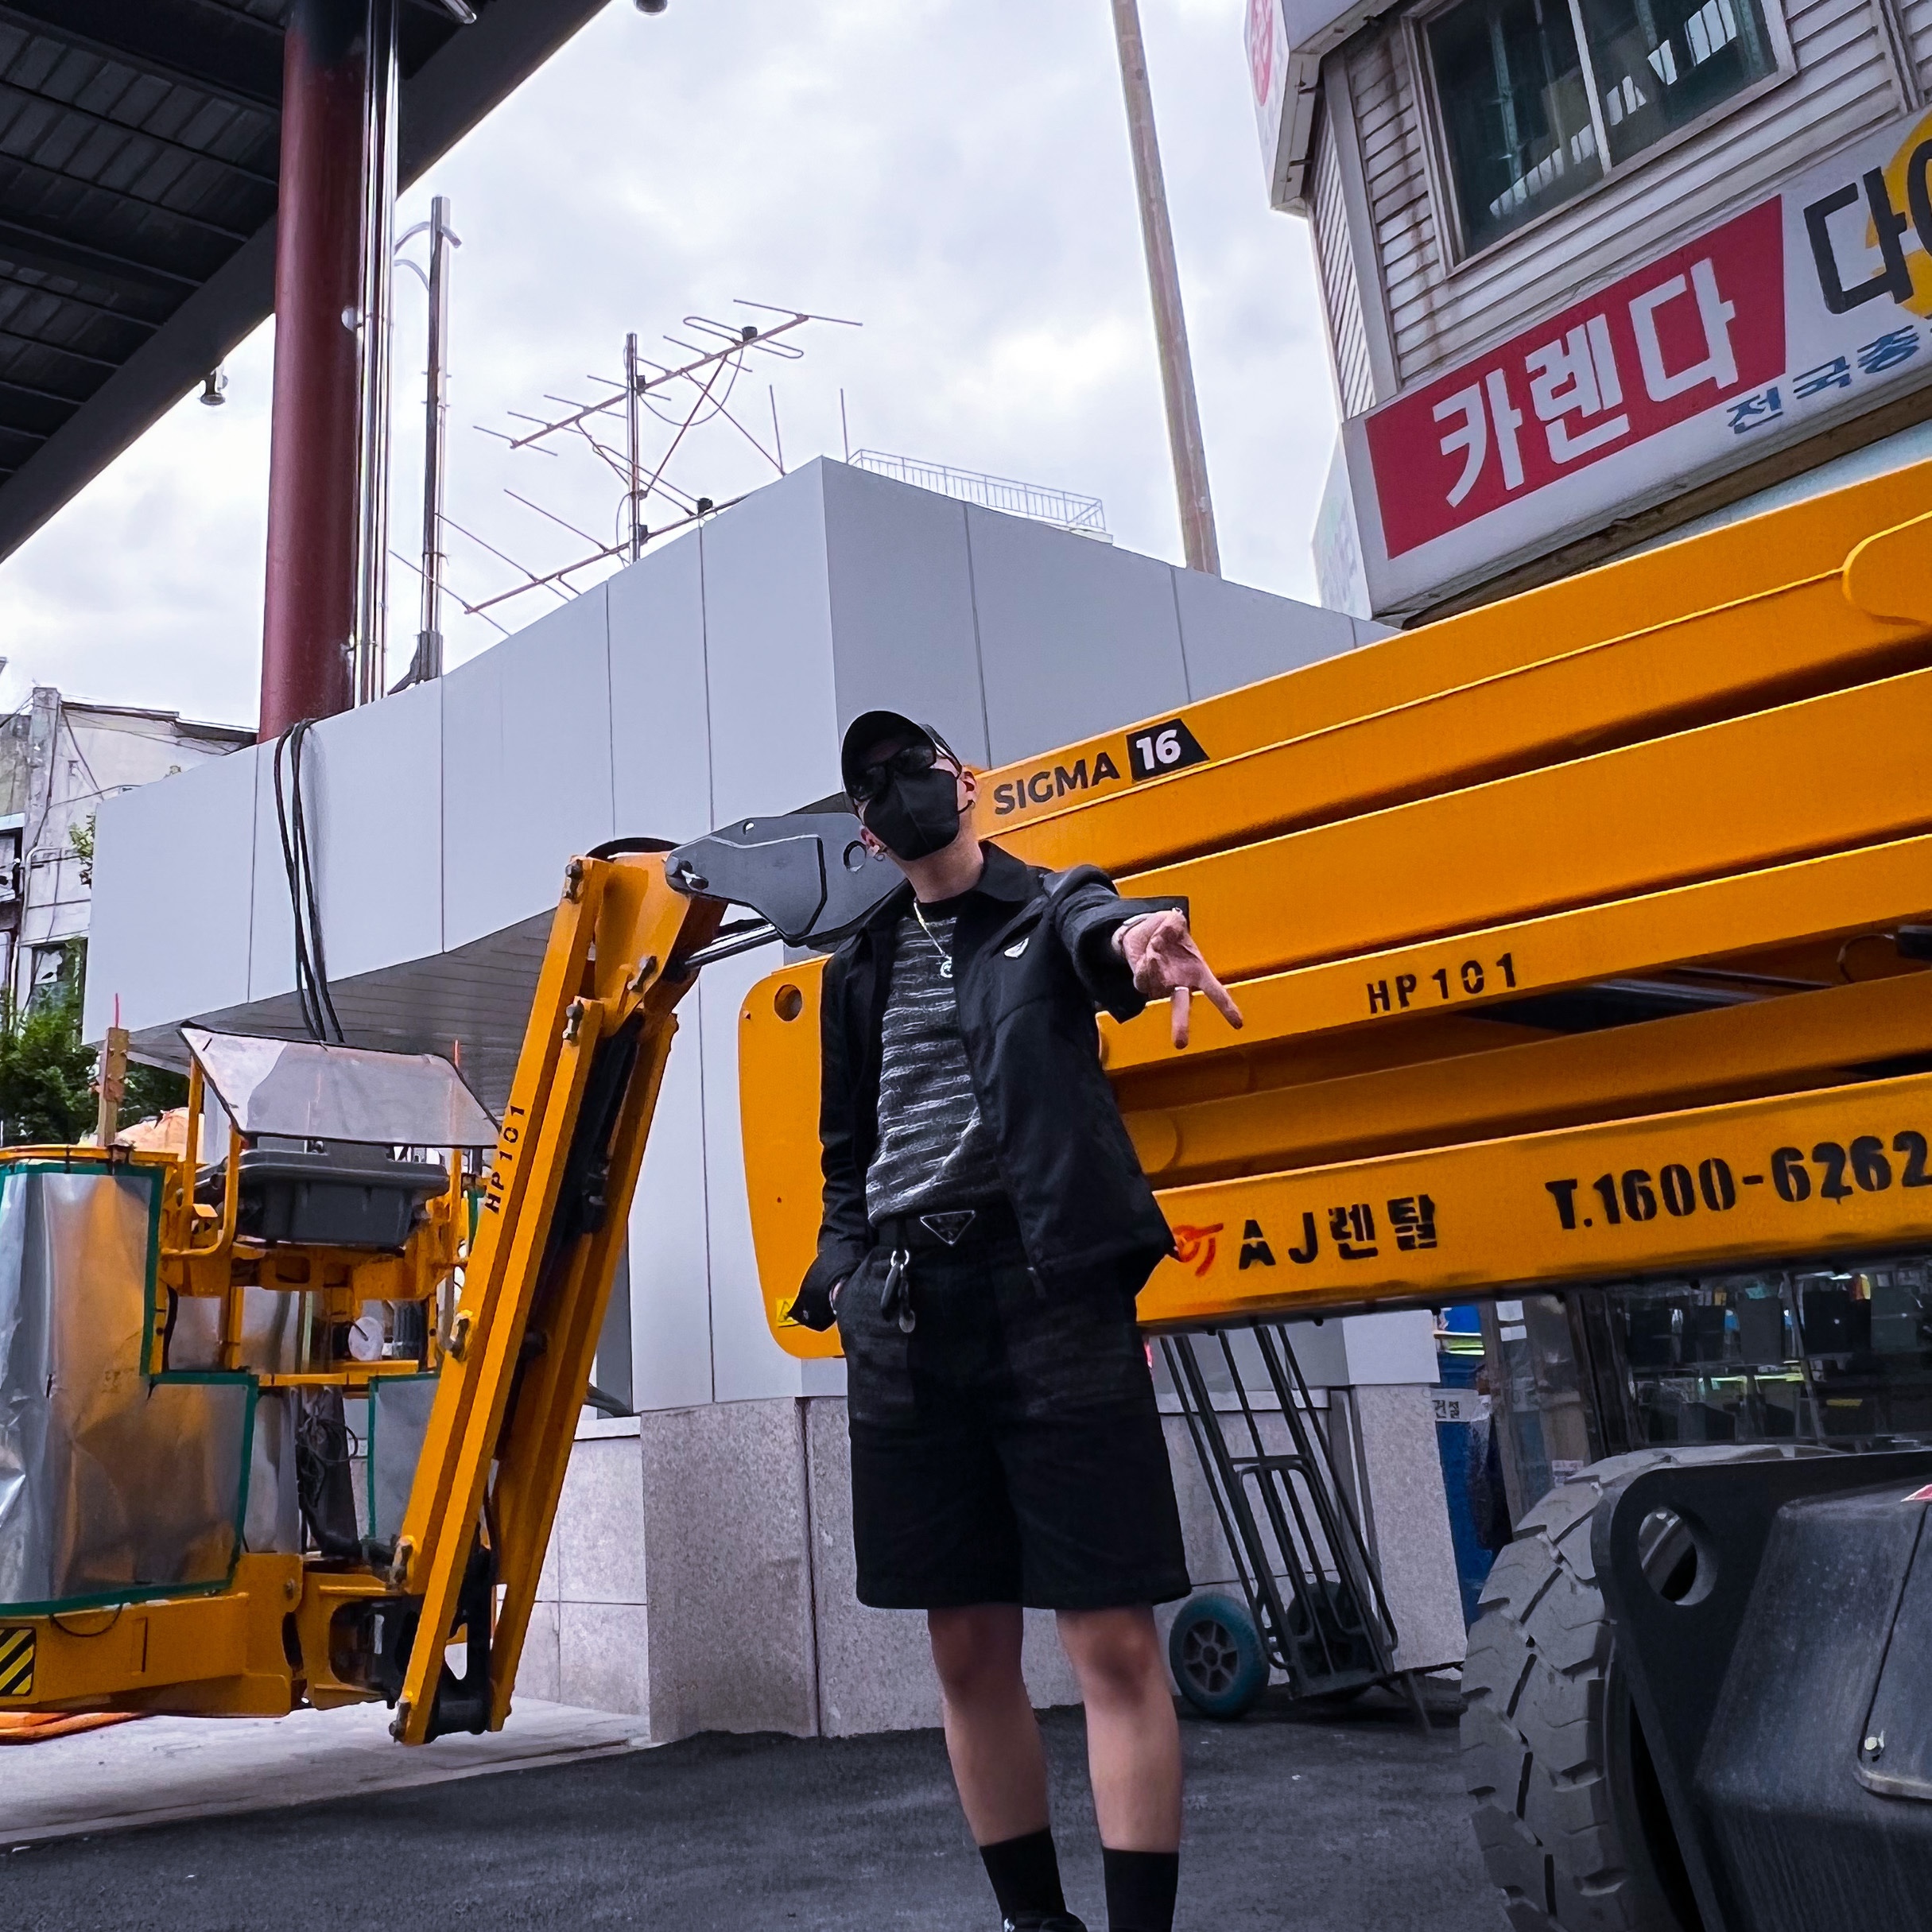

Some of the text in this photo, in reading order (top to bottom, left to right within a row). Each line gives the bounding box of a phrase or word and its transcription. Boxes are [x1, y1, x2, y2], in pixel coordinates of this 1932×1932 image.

[1433, 258, 1739, 507] 카렌다
[1726, 324, 1932, 434] 전국총
[994, 729, 1181, 816] SIGMA 16
[1545, 1130, 1932, 1230] T.1600-6262
